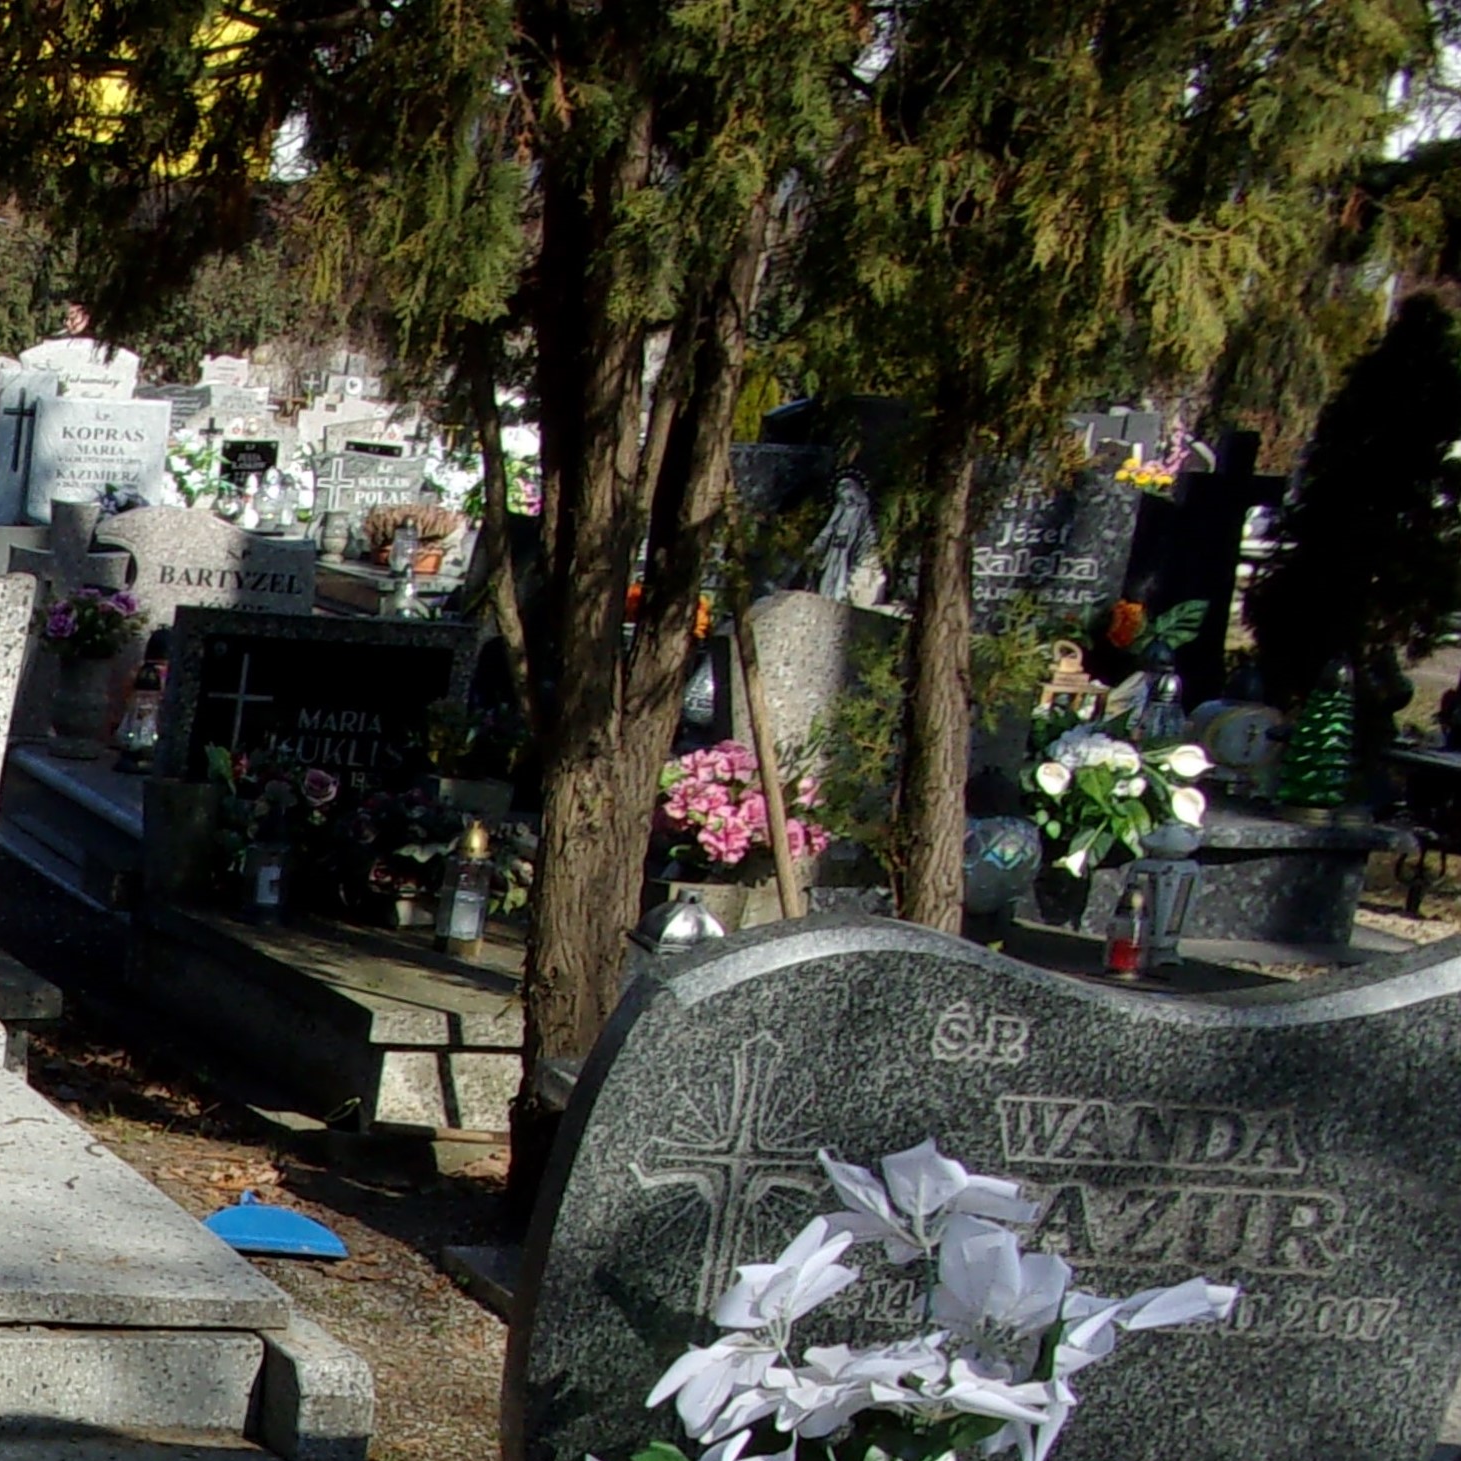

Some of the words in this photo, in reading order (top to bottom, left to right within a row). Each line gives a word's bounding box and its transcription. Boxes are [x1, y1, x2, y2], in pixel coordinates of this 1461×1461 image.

[159, 564, 303, 595] BARTYZEL
[297, 707, 382, 734] MARIA
[997, 1095, 1307, 1175] WANDA
[1030, 1180, 1349, 1278] AZUR
